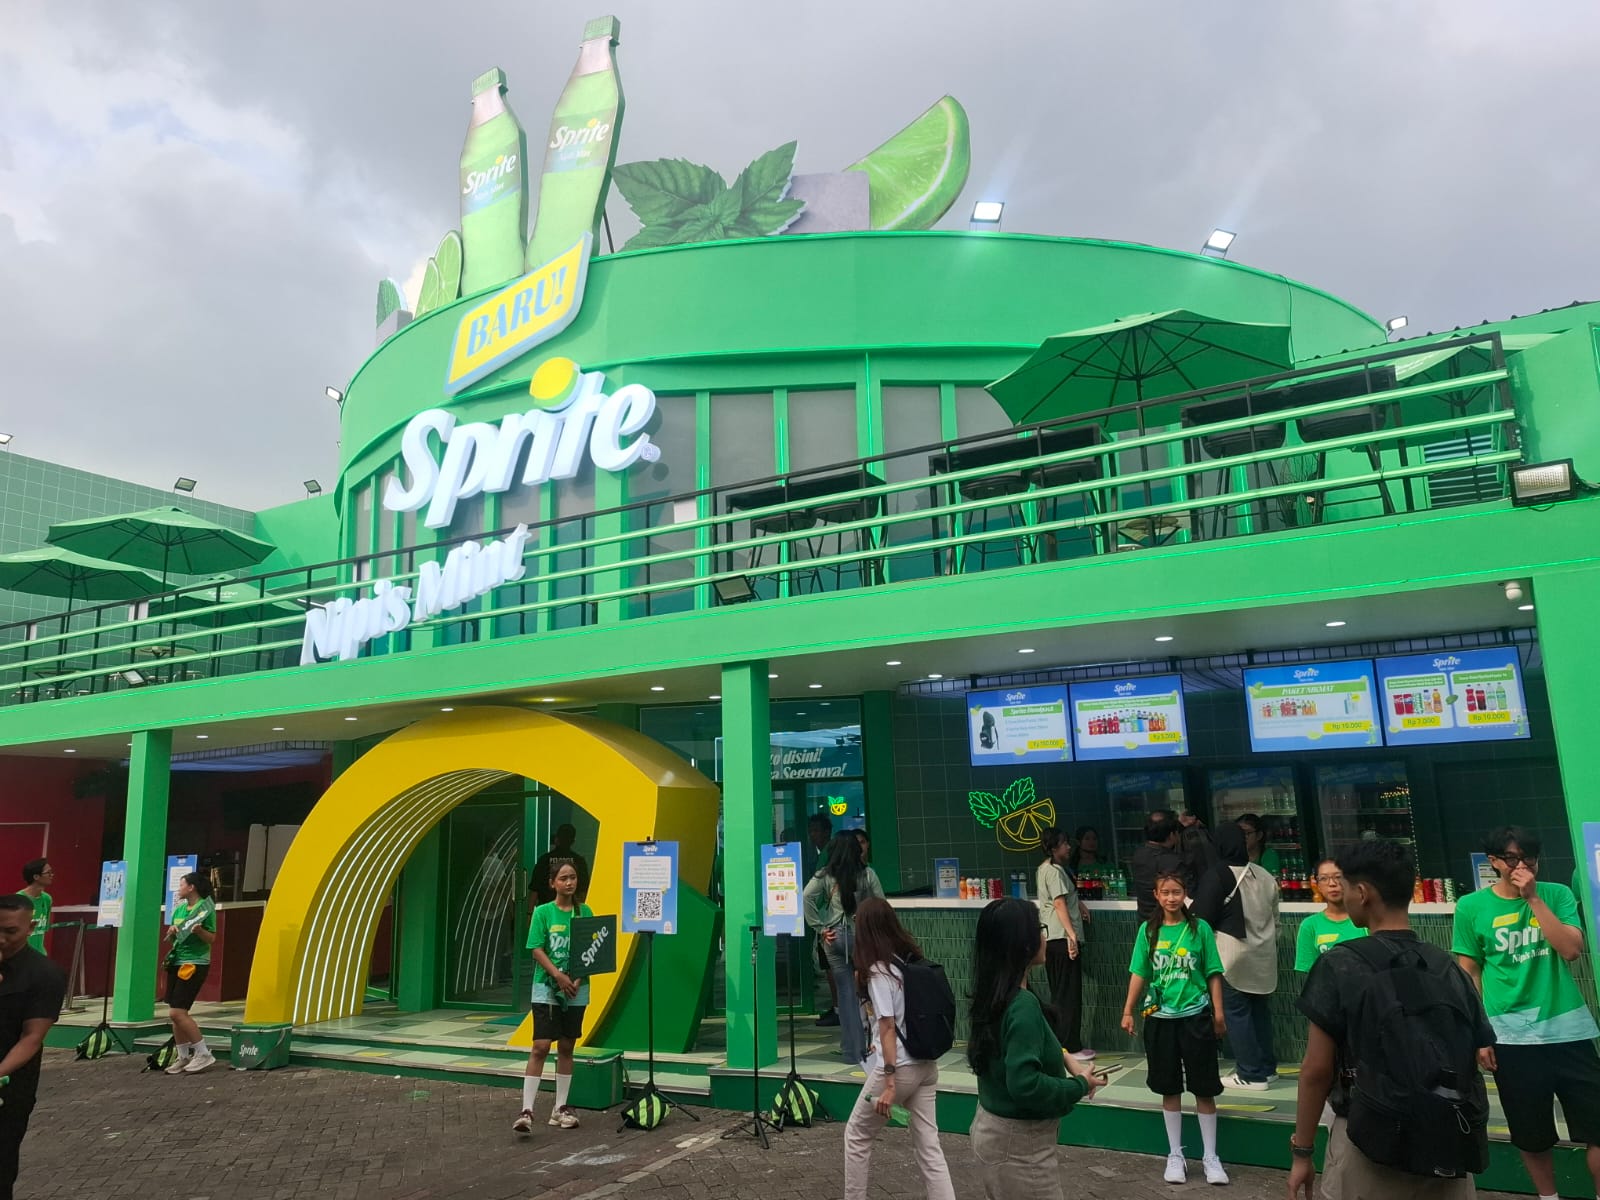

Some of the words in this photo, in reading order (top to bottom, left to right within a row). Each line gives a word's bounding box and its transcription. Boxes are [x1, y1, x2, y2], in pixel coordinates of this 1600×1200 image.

[551, 118, 610, 150] Sprite
[463, 154, 517, 194] Sprite
[465, 266, 567, 359] BARU!
[383, 356, 657, 529] Sprite
[300, 580, 413, 665] Nipis
[414, 523, 532, 622] Mint
[1433, 656, 1460, 668] Sprite
[783, 748, 824, 765] disini!
[581, 925, 609, 968] Sprite
[1152, 947, 1198, 971] Spite
[239, 1044, 259, 1058] Sprite
